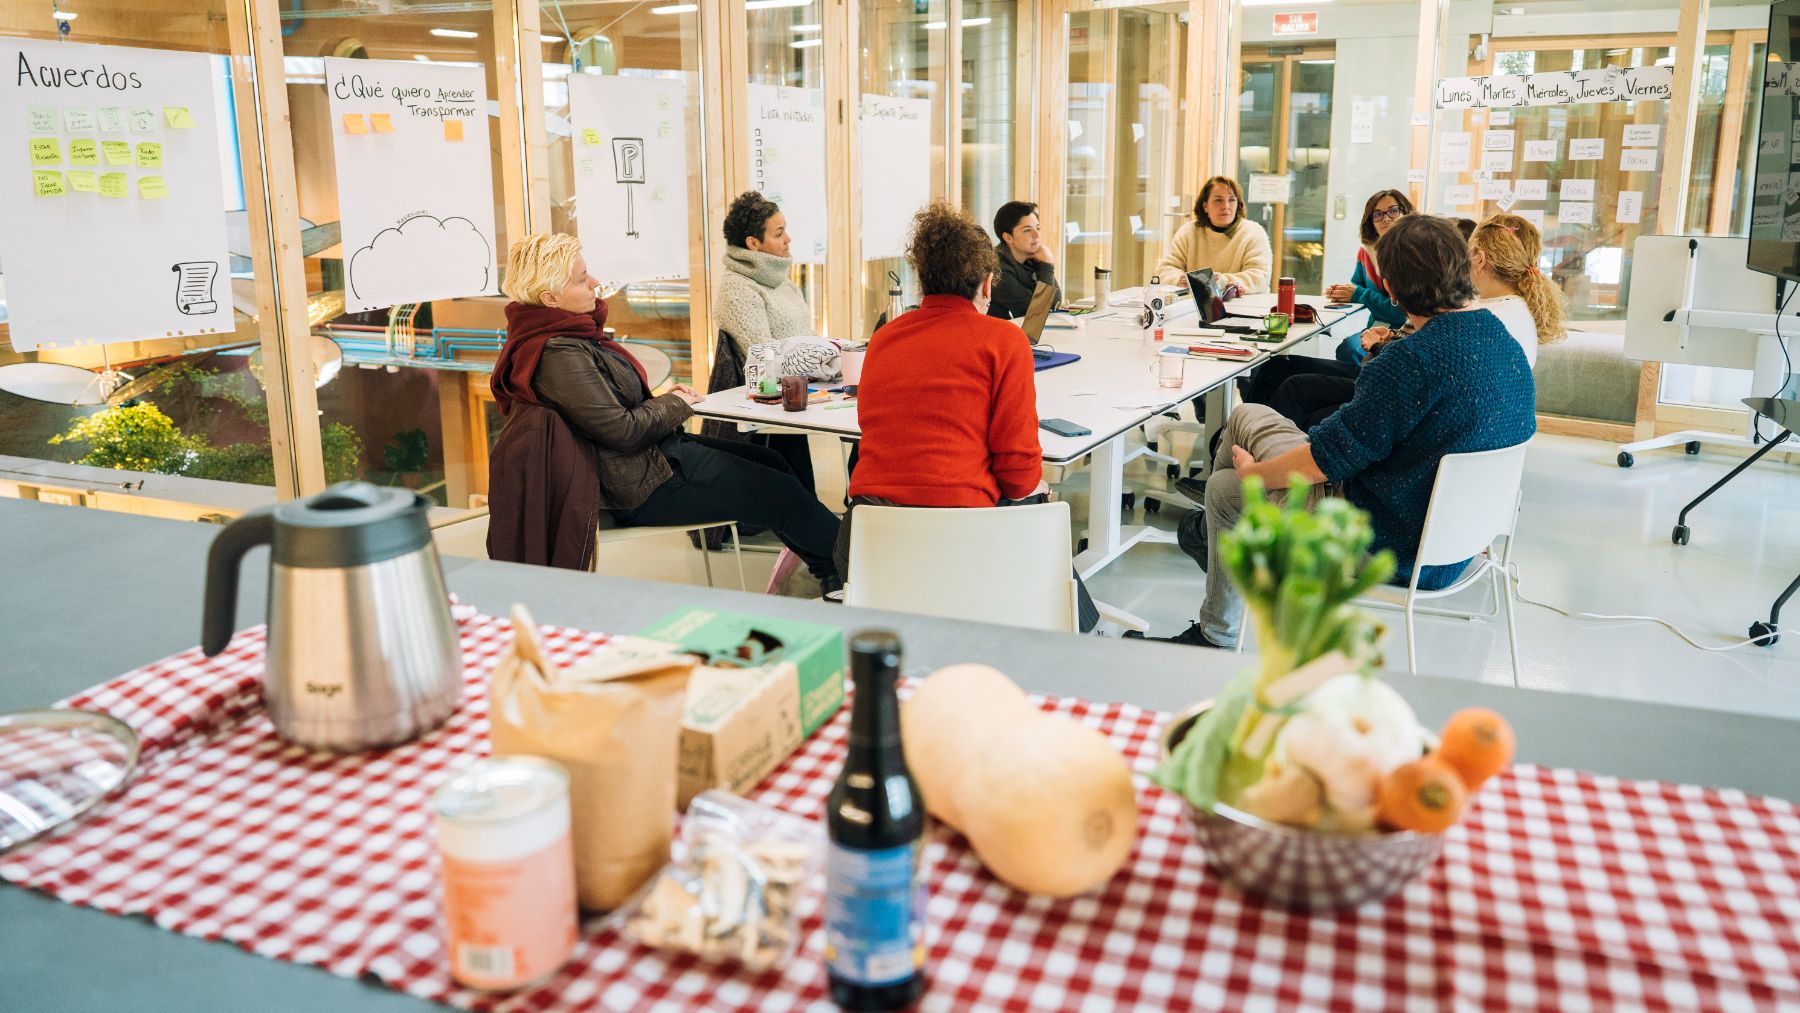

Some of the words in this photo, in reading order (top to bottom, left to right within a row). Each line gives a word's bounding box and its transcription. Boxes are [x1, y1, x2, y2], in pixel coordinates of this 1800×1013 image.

[1280, 22, 1310, 32] SALIDA
[18, 51, 143, 91] Acuerdos
[334, 73, 384, 100] ¿Qué
[391, 86, 431, 106] quiero
[437, 87, 476, 102] Aprender
[1442, 86, 1473, 103] Lunes
[1483, 83, 1517, 101] Martes
[1527, 82, 1569, 99] Miércoles
[1576, 79, 1615, 100] Jueves
[1625, 77, 1669, 96] Viernes
[407, 104, 477, 122] Transformar
